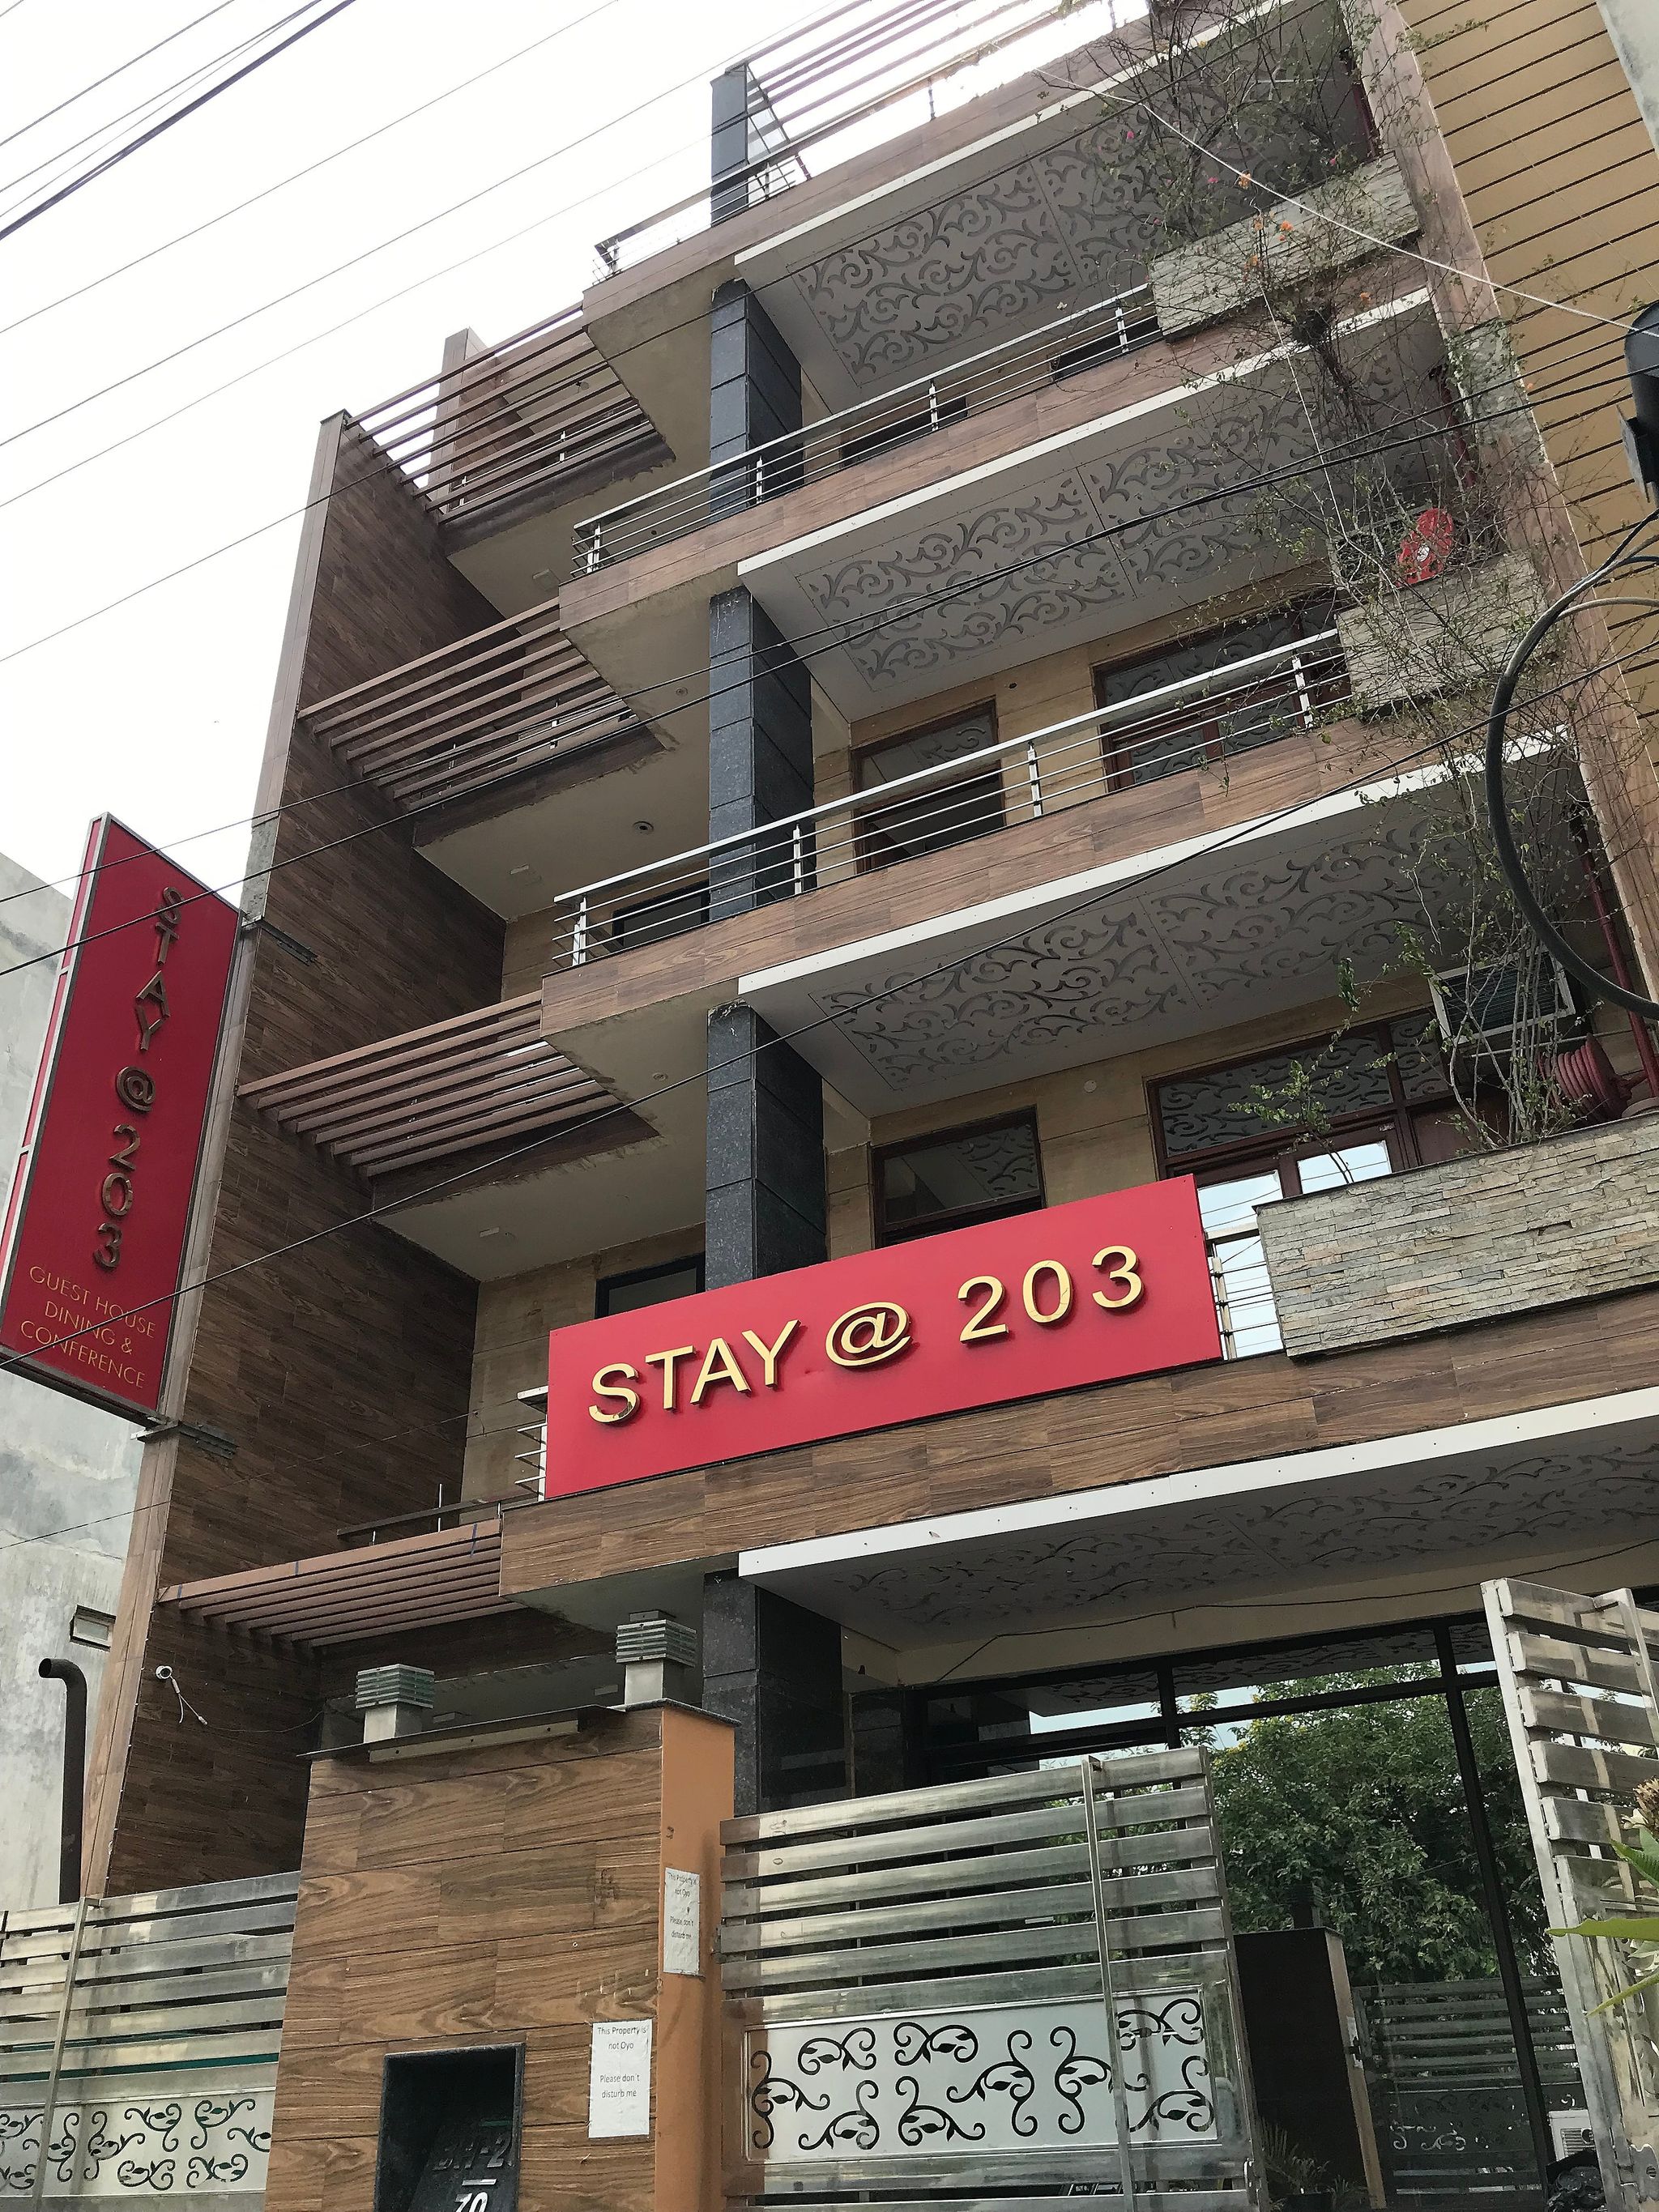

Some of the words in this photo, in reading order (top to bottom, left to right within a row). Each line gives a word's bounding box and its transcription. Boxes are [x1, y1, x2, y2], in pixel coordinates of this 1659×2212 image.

[136, 886, 185, 1051] STAY
[117, 1066, 156, 1112] @
[93, 1123, 140, 1268] 203
[29, 1266, 91, 1305] GUEST
[96, 1297, 156, 1339] HOUSE
[45, 1301, 115, 1345] DINING
[121, 1337, 133, 1355] &
[21, 1320, 146, 1388] CONFERENCE
[588, 1319, 802, 1425] STAY
[825, 1302, 914, 1368] @
[957, 1244, 1145, 1343] 203
[598, 2027, 610, 2035] This
[612, 2026, 640, 2036] Property
[608, 2042, 620, 2050] not
[621, 2041, 633, 2051] Oyo
[600, 2074, 621, 2082] Please
[622, 2073, 640, 2082] don't
[601, 2090, 625, 2099] disturb
